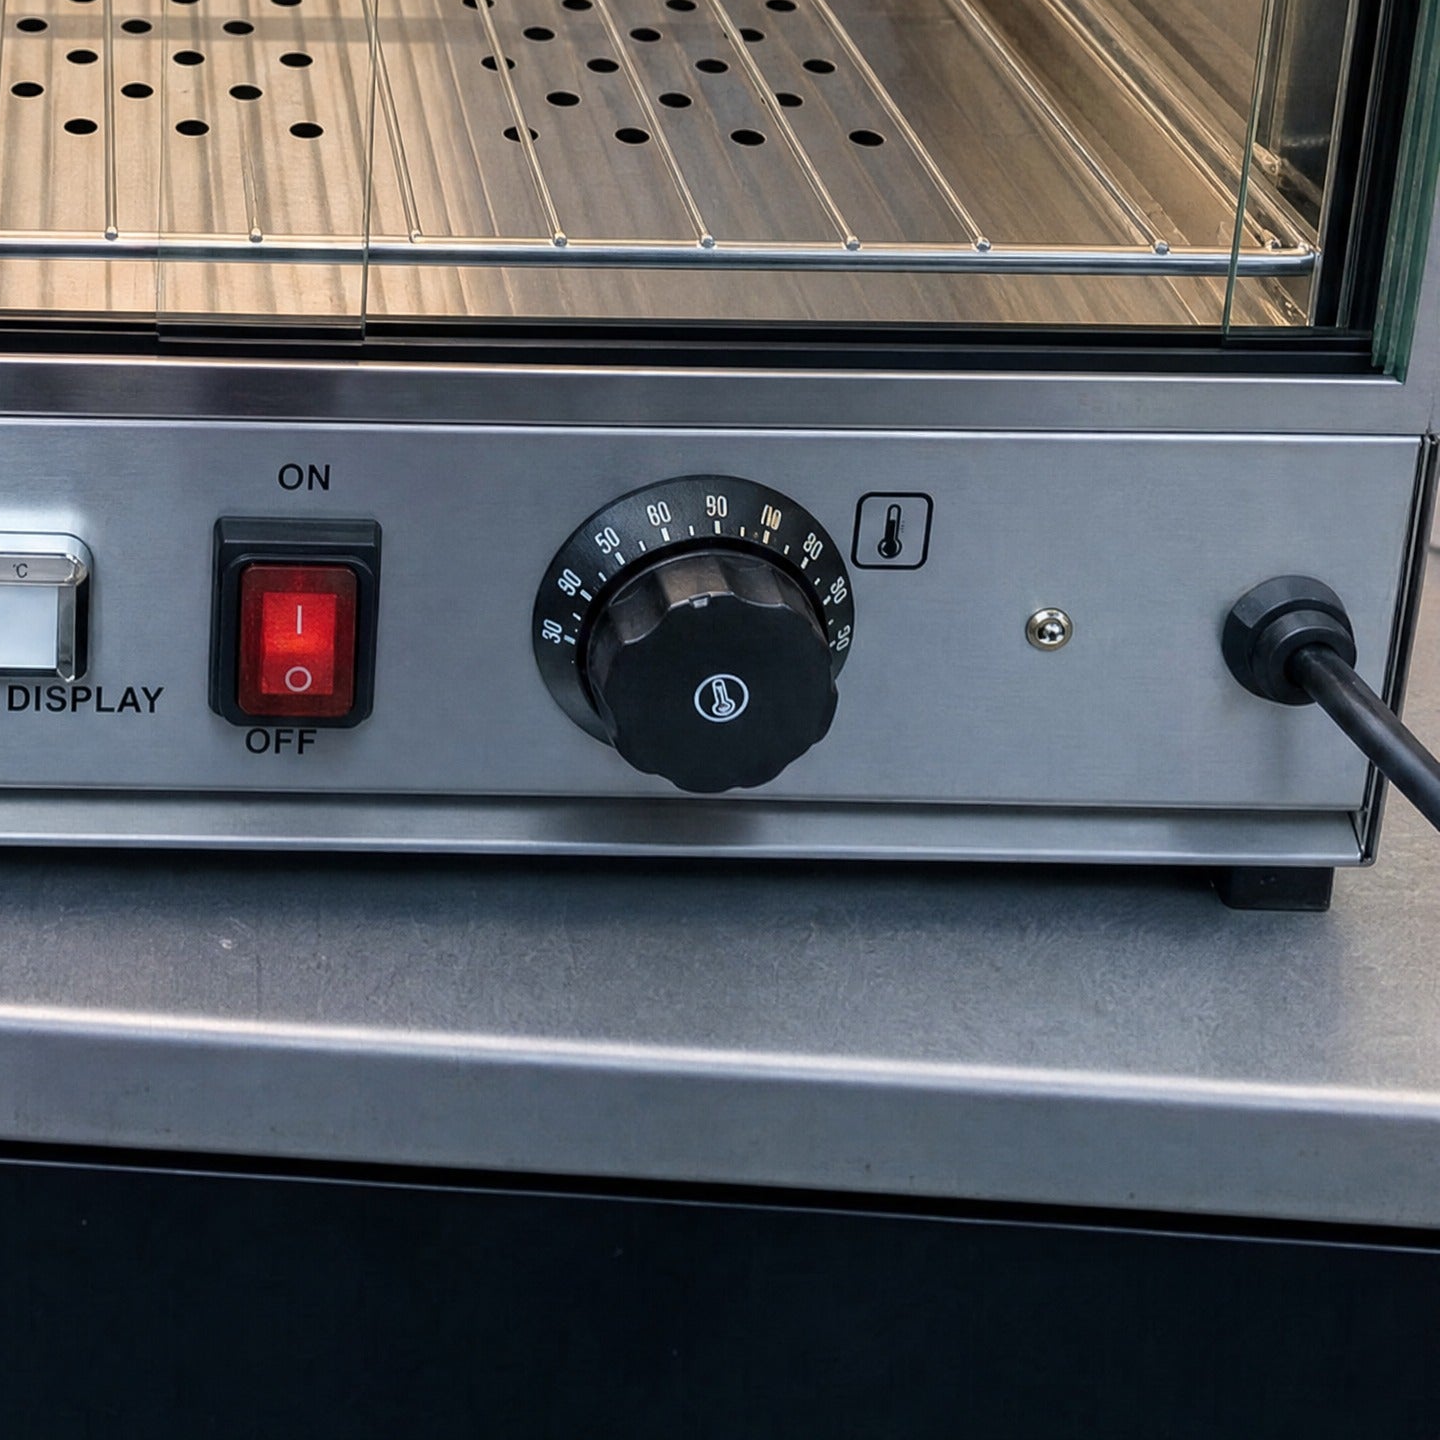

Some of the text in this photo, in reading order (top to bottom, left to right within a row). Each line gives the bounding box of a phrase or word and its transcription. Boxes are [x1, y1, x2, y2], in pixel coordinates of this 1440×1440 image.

[278, 463, 331, 491] ON
[646, 501, 672, 527] 60
[594, 526, 621, 554] 50
[541, 618, 563, 644] 30
[7, 686, 165, 714] DISPLAY
[245, 728, 318, 755] OFF
